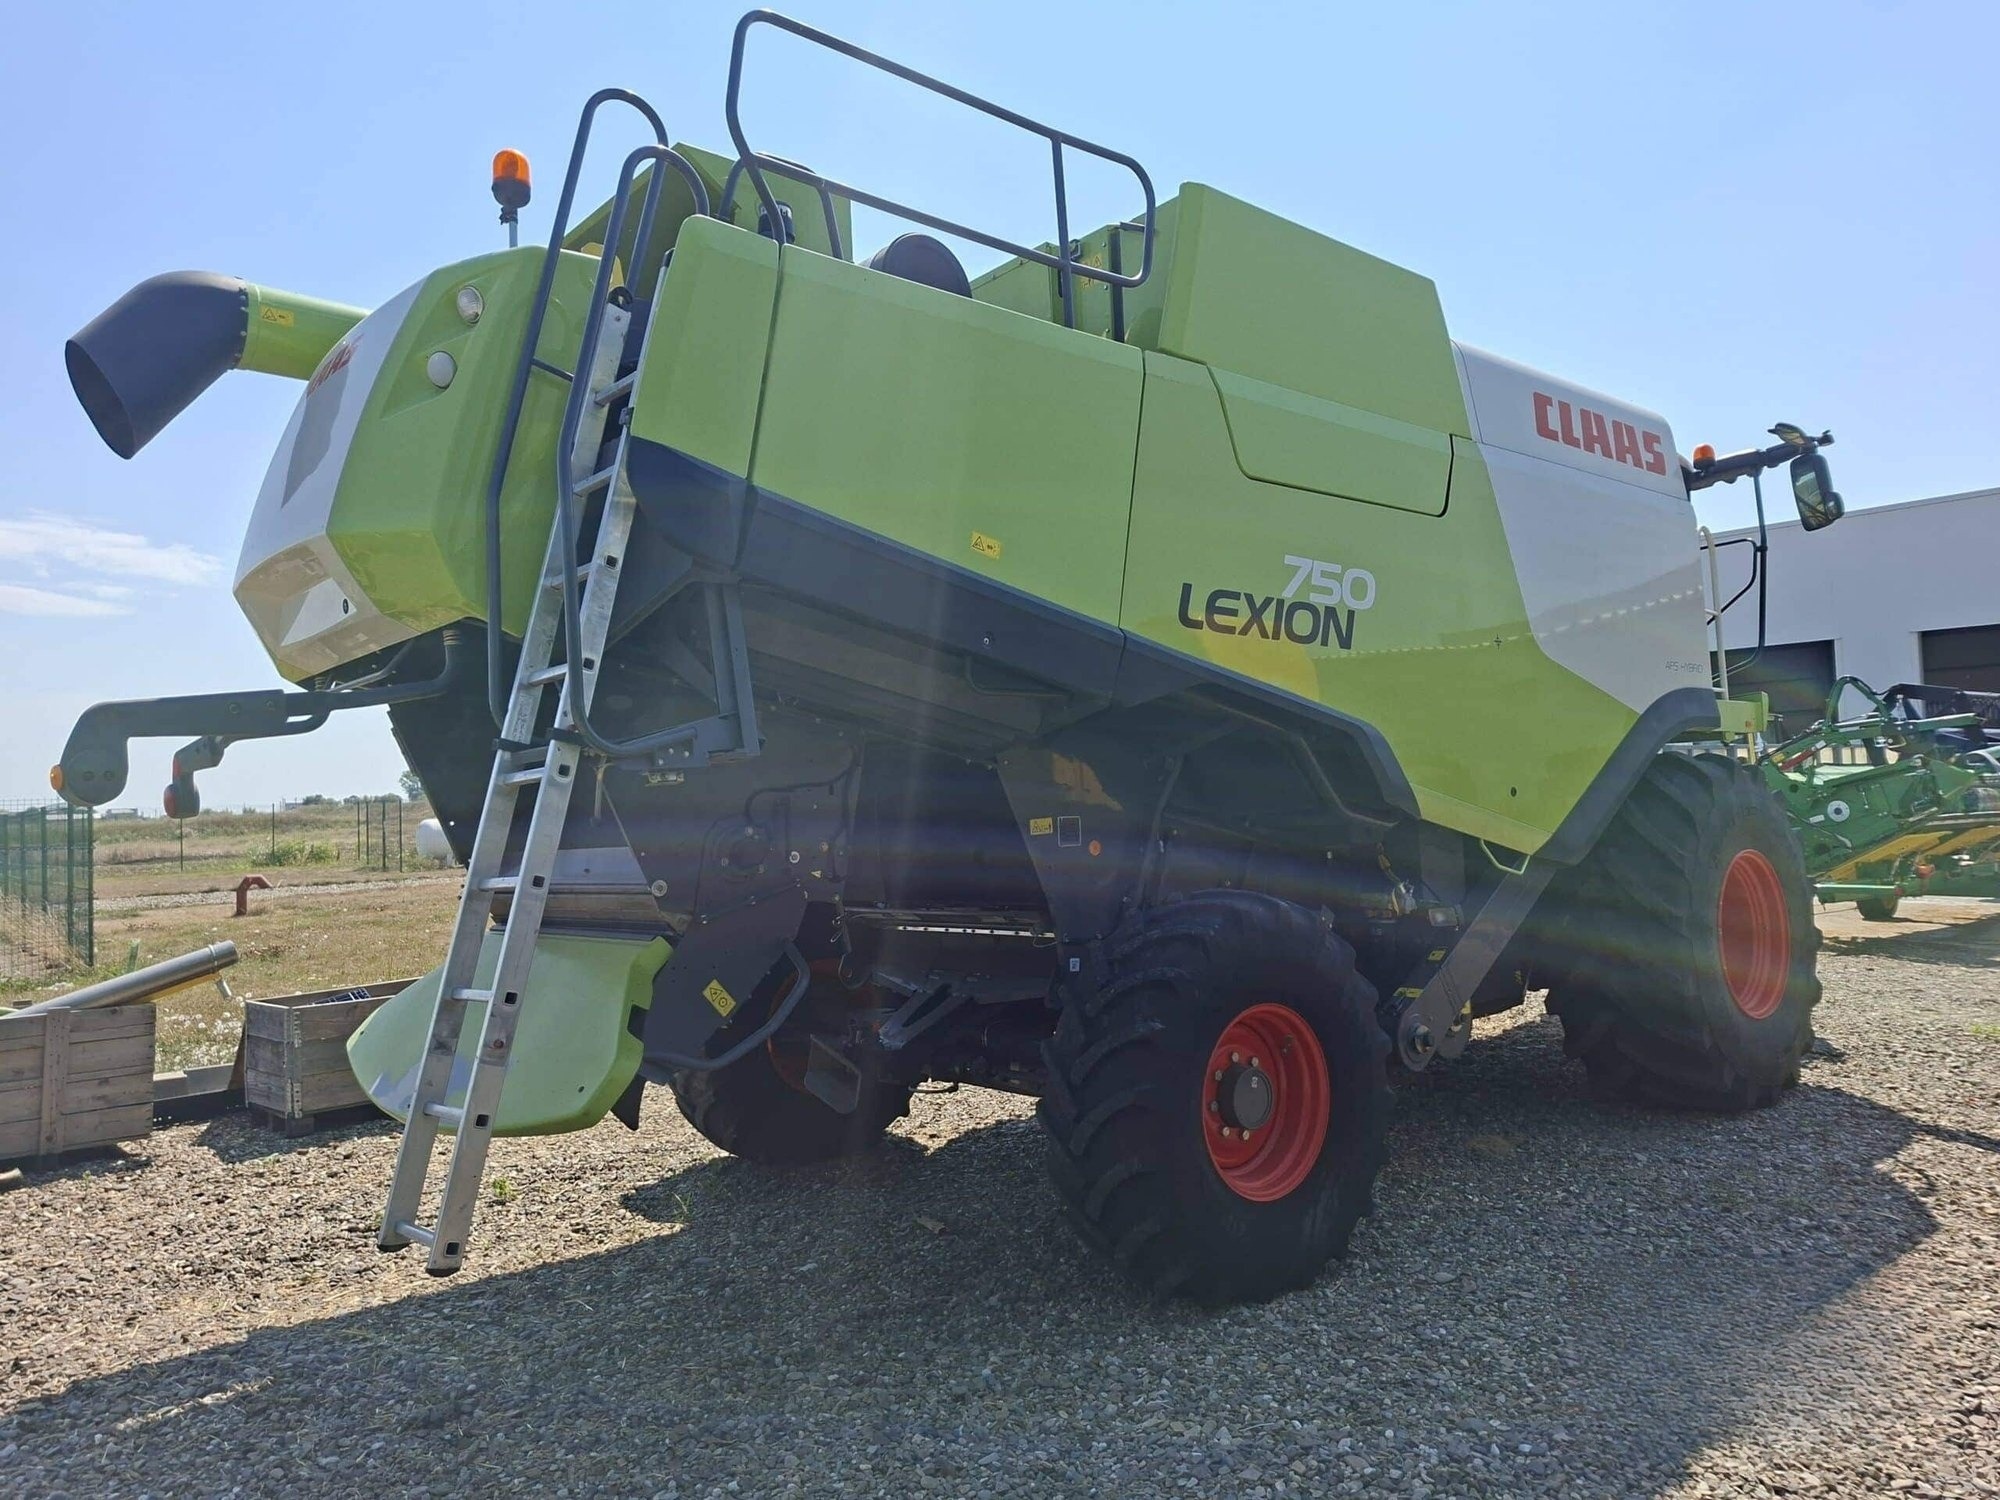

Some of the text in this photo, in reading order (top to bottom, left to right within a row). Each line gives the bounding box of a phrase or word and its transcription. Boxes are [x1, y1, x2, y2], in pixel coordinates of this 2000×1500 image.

[1532, 391, 1667, 476] CLAAS
[1178, 582, 1356, 650] LEXION
[1281, 554, 1376, 610] 750
